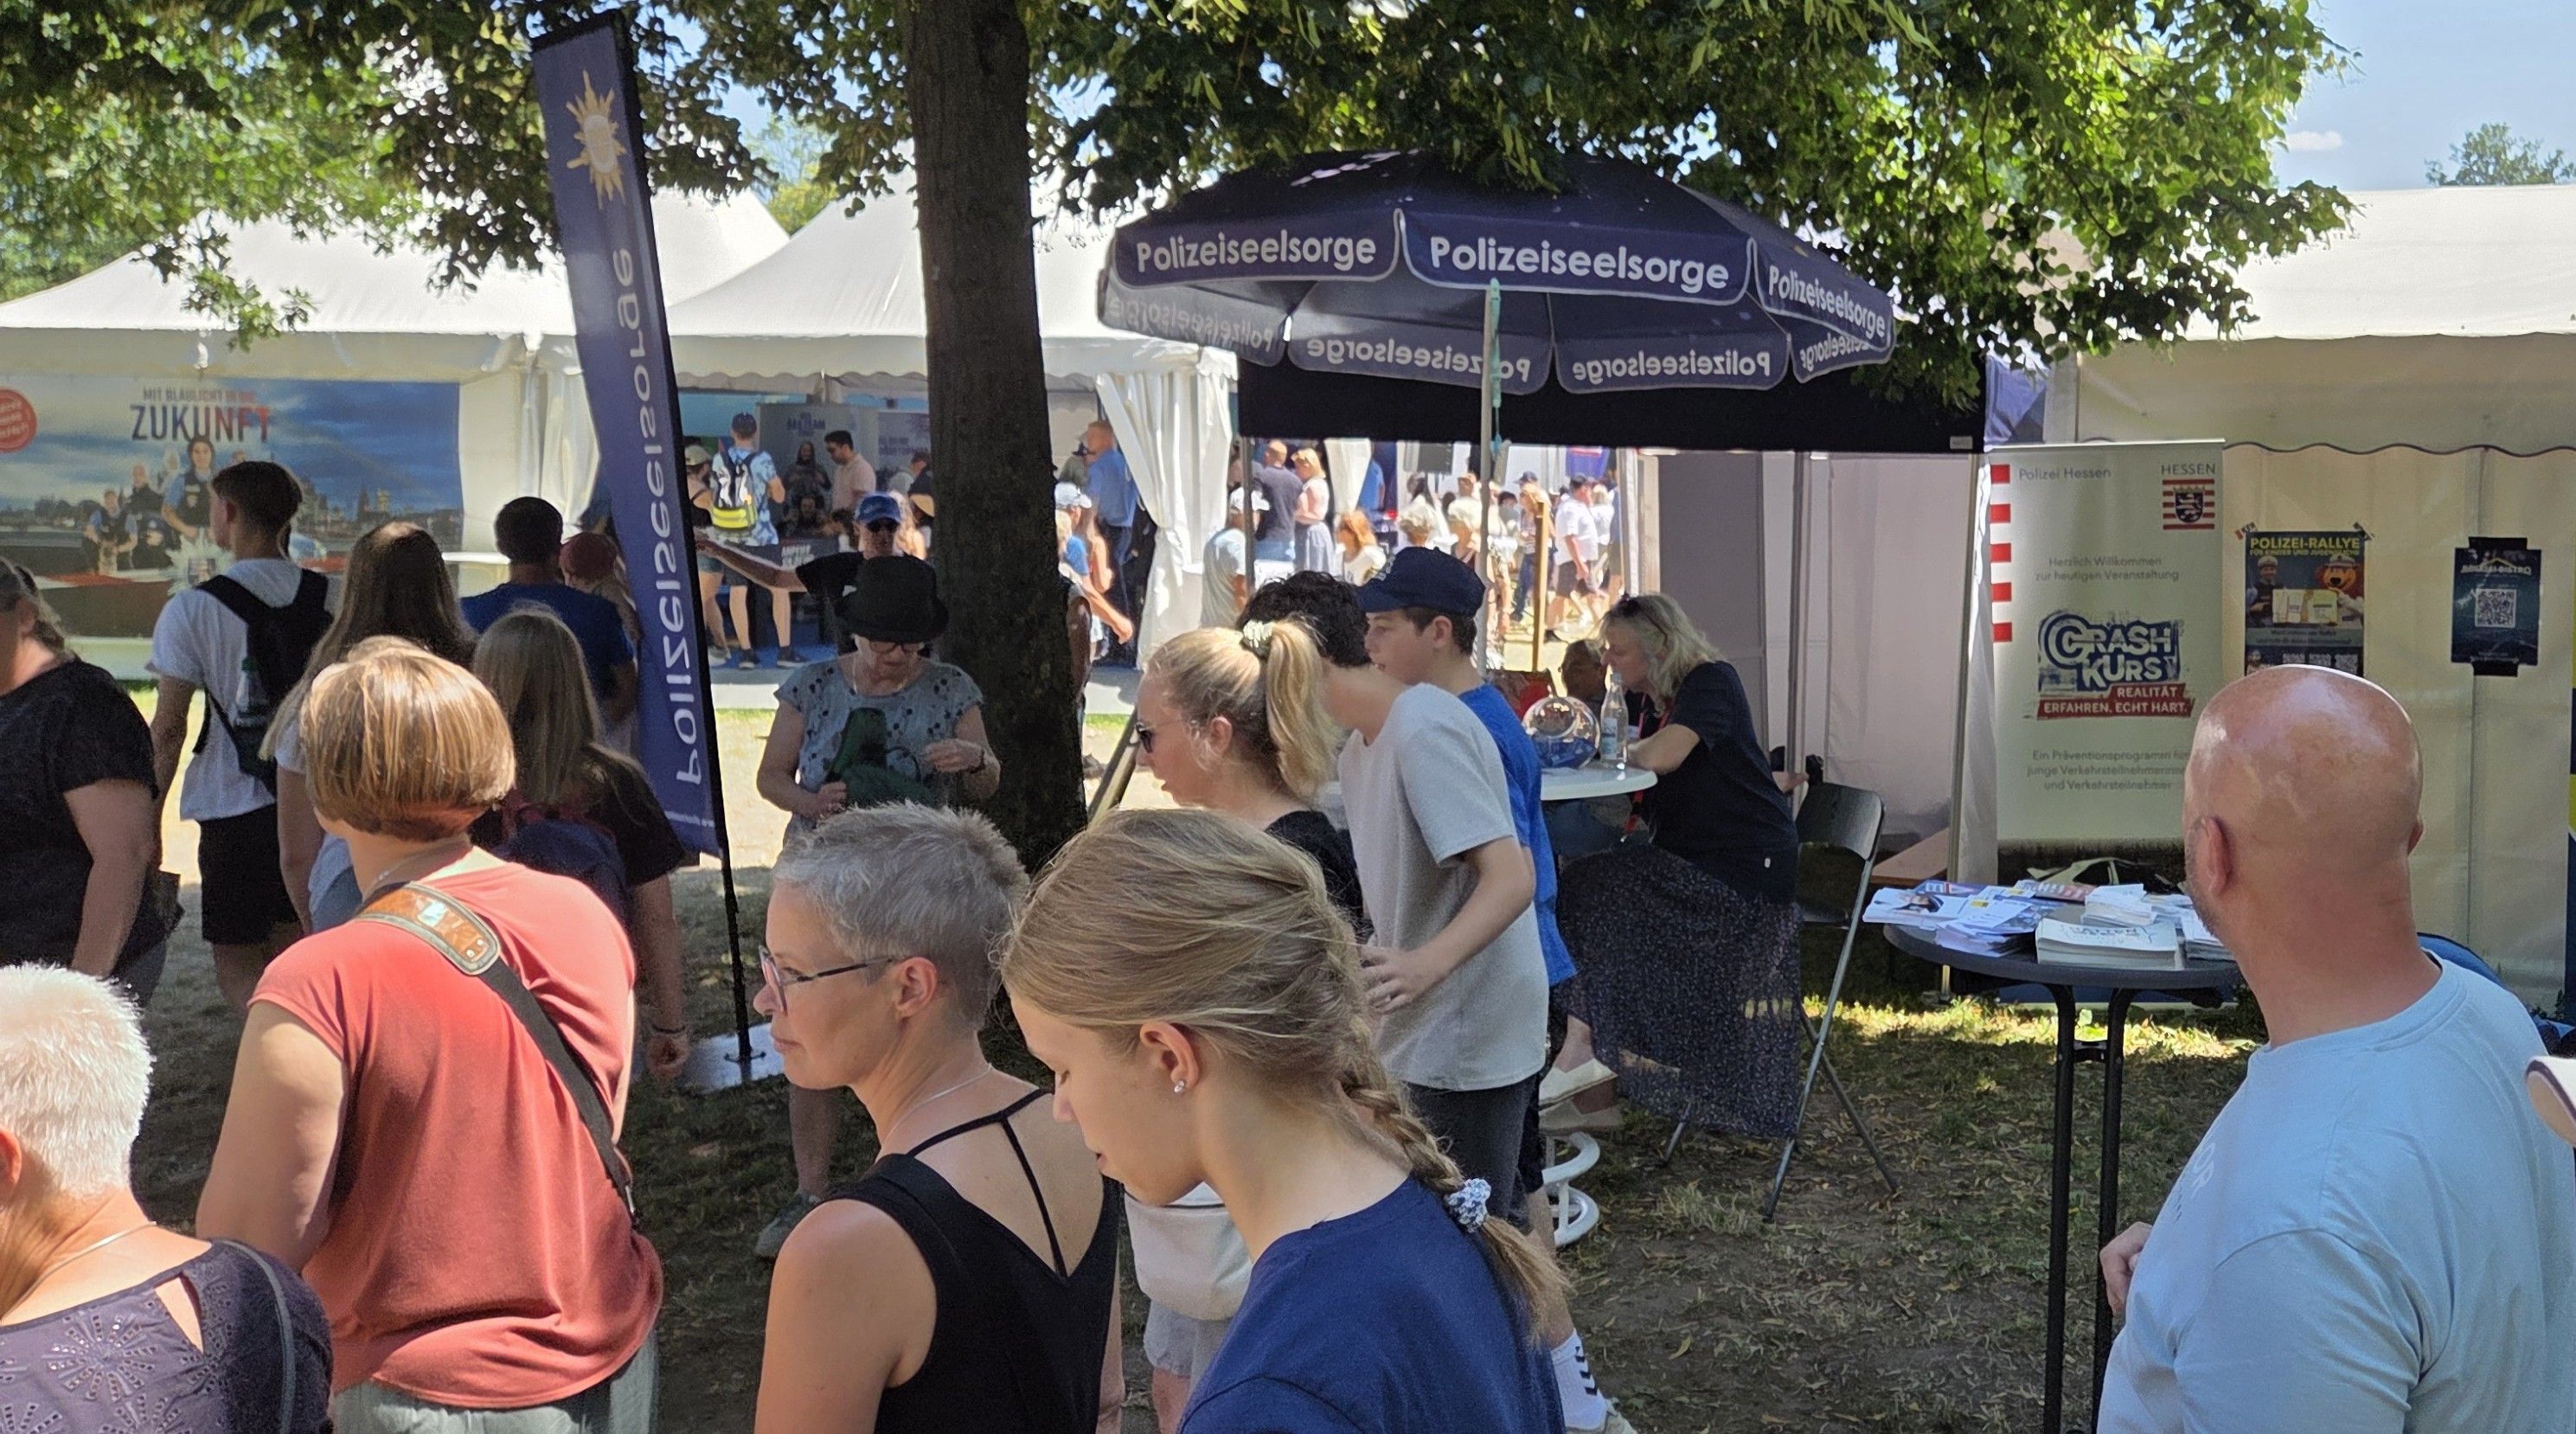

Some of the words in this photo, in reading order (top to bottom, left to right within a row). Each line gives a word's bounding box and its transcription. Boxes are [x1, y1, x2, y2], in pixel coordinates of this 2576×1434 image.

[1137, 229, 1376, 272] Polizeiseelsorge
[1430, 236, 1729, 294] Polizeiseelsorge
[1769, 266, 1886, 340] Polizeiseelsorge
[130, 404, 270, 444] ZUKUNFT
[2019, 467, 2060, 481] Polizei
[2063, 466, 2111, 479] Hessen
[2161, 463, 2216, 476] HESSEN
[2250, 536, 2361, 549] POLIZEI-RALLYE
[2048, 556, 2092, 567] Herzlich
[2093, 556, 2163, 567] Willkommen
[2035, 573, 2051, 582] zur
[2054, 569, 2102, 584] heutigen
[2104, 568, 2180, 583] Veranstaltung
[2047, 617, 2172, 666] CRASH
[2082, 655, 2163, 688] KURS
[2117, 685, 2178, 698] REALITÄT
[2043, 701, 2113, 714] ERFAHREN.
[2115, 701, 2149, 714] ECHT
[2150, 700, 2188, 714] HART.
[2033, 750, 2049, 761] Ein
[2044, 780, 2066, 791] und
